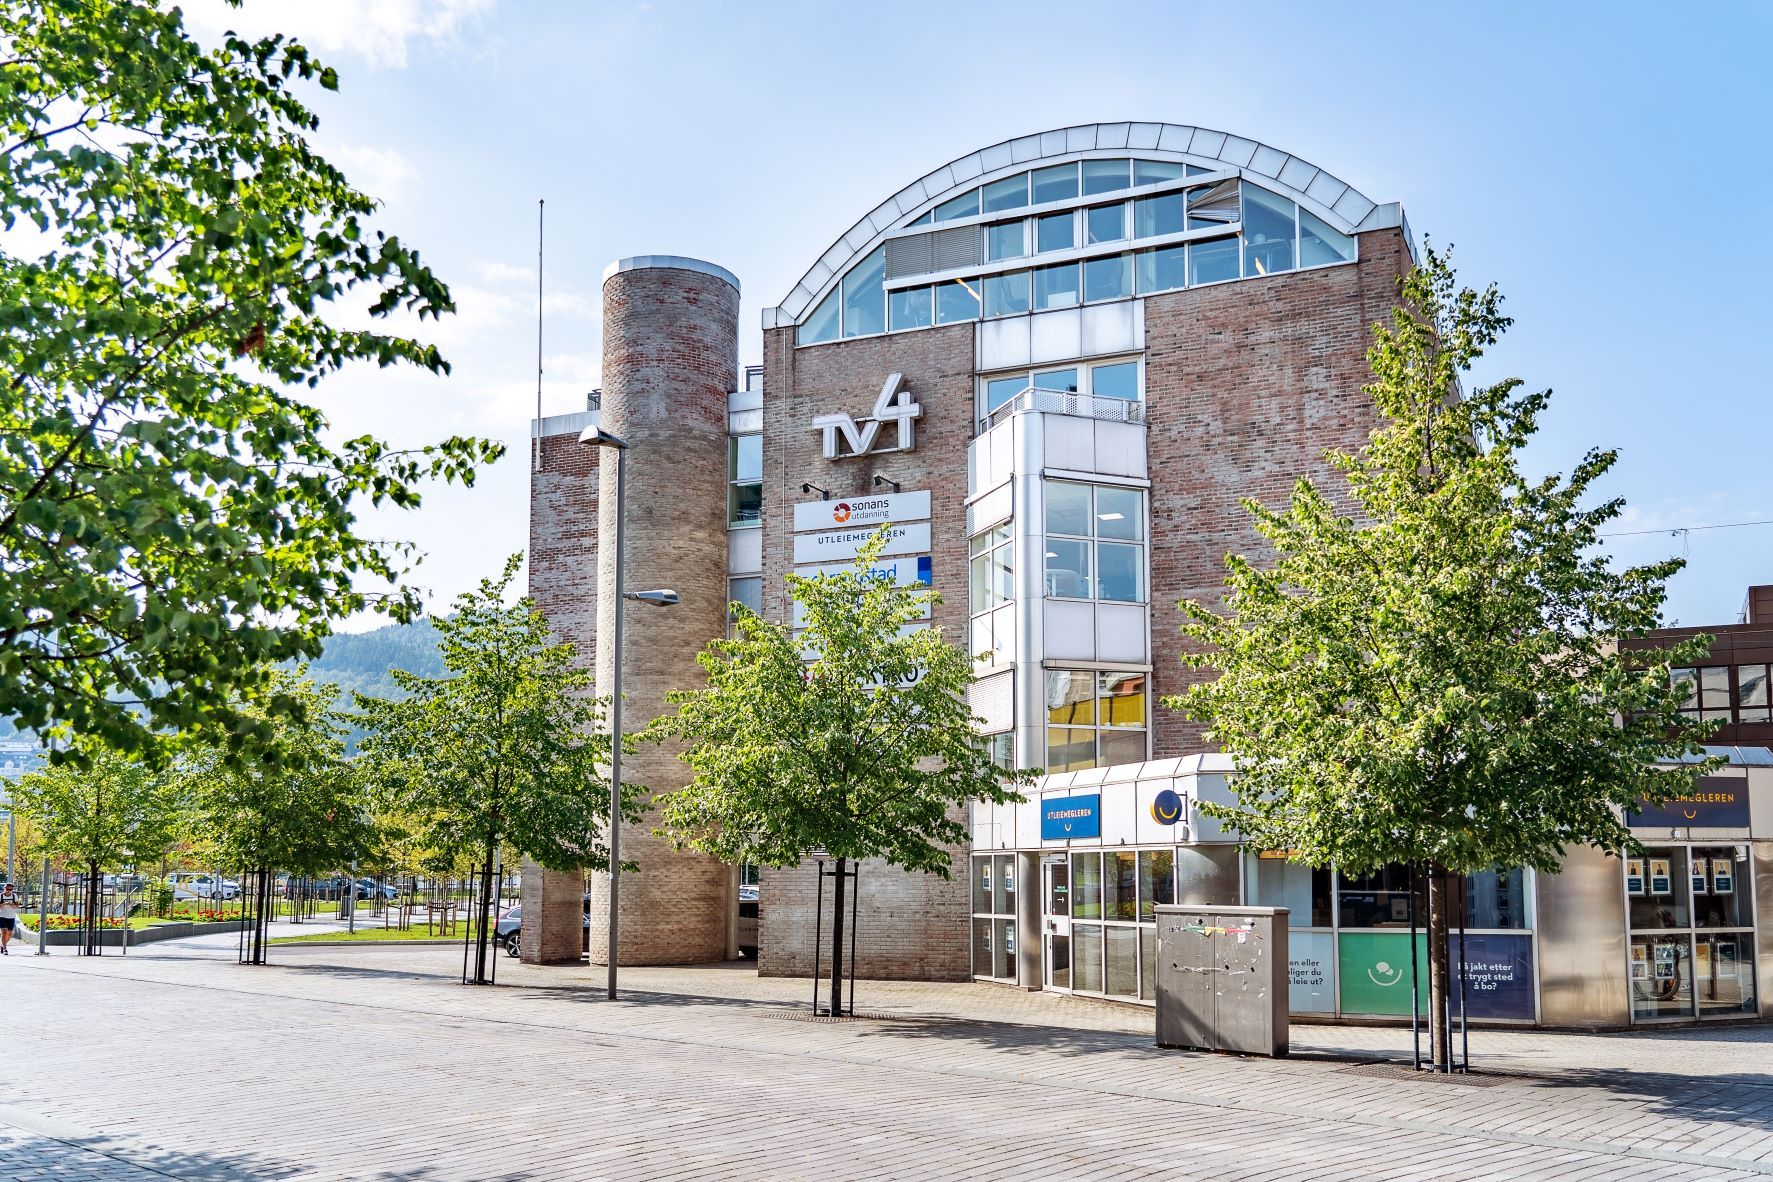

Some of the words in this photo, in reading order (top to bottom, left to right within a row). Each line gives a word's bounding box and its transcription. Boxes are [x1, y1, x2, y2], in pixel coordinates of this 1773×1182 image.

[812, 372, 923, 460] TV4
[852, 499, 889, 512] sonans
[851, 509, 889, 520] utdanning
[818, 529, 906, 544] UTLEIEMEGEREN
[1643, 793, 1734, 803] UEEMEGLEREN
[1301, 958, 1320, 966] eller
[1470, 962, 1487, 972] jakt
[1489, 963, 1512, 971] etter
[1311, 968, 1322, 976] du
[1469, 973, 1491, 982] trygt
[1493, 972, 1513, 981] sted
[1293, 977, 1308, 985] leie
[1310, 977, 1324, 985] ut?
[1473, 982, 1479, 990] å
[1481, 982, 1497, 990] bo?
